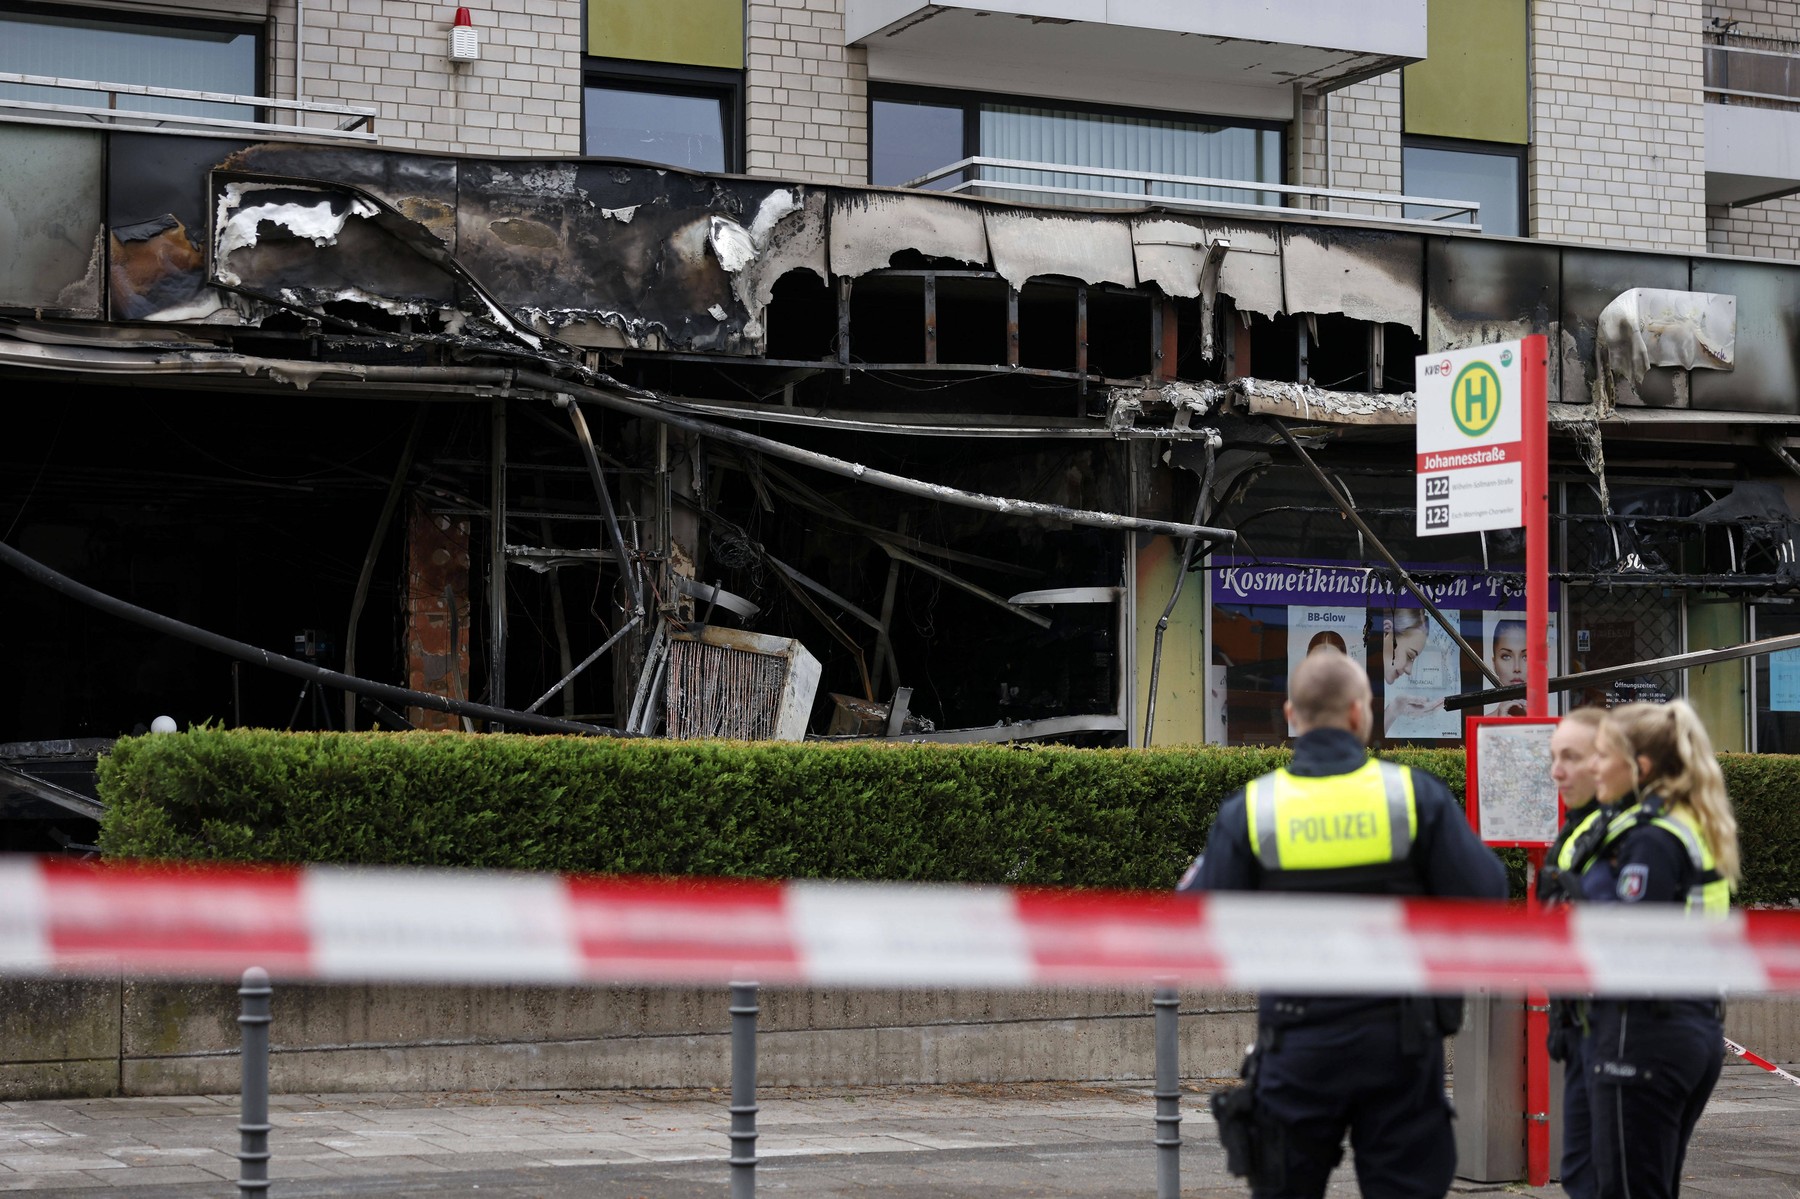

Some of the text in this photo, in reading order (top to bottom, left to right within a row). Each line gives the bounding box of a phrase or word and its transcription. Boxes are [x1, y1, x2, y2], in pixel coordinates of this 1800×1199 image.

[1425, 364, 1440, 376] KVB
[1465, 375, 1487, 422] H
[1424, 447, 1506, 470] Johannesstraße
[1427, 479, 1448, 496] 122
[1427, 507, 1448, 524] 123
[1307, 612, 1346, 622] BB-Glow
[1289, 811, 1377, 844] POLIZEI
